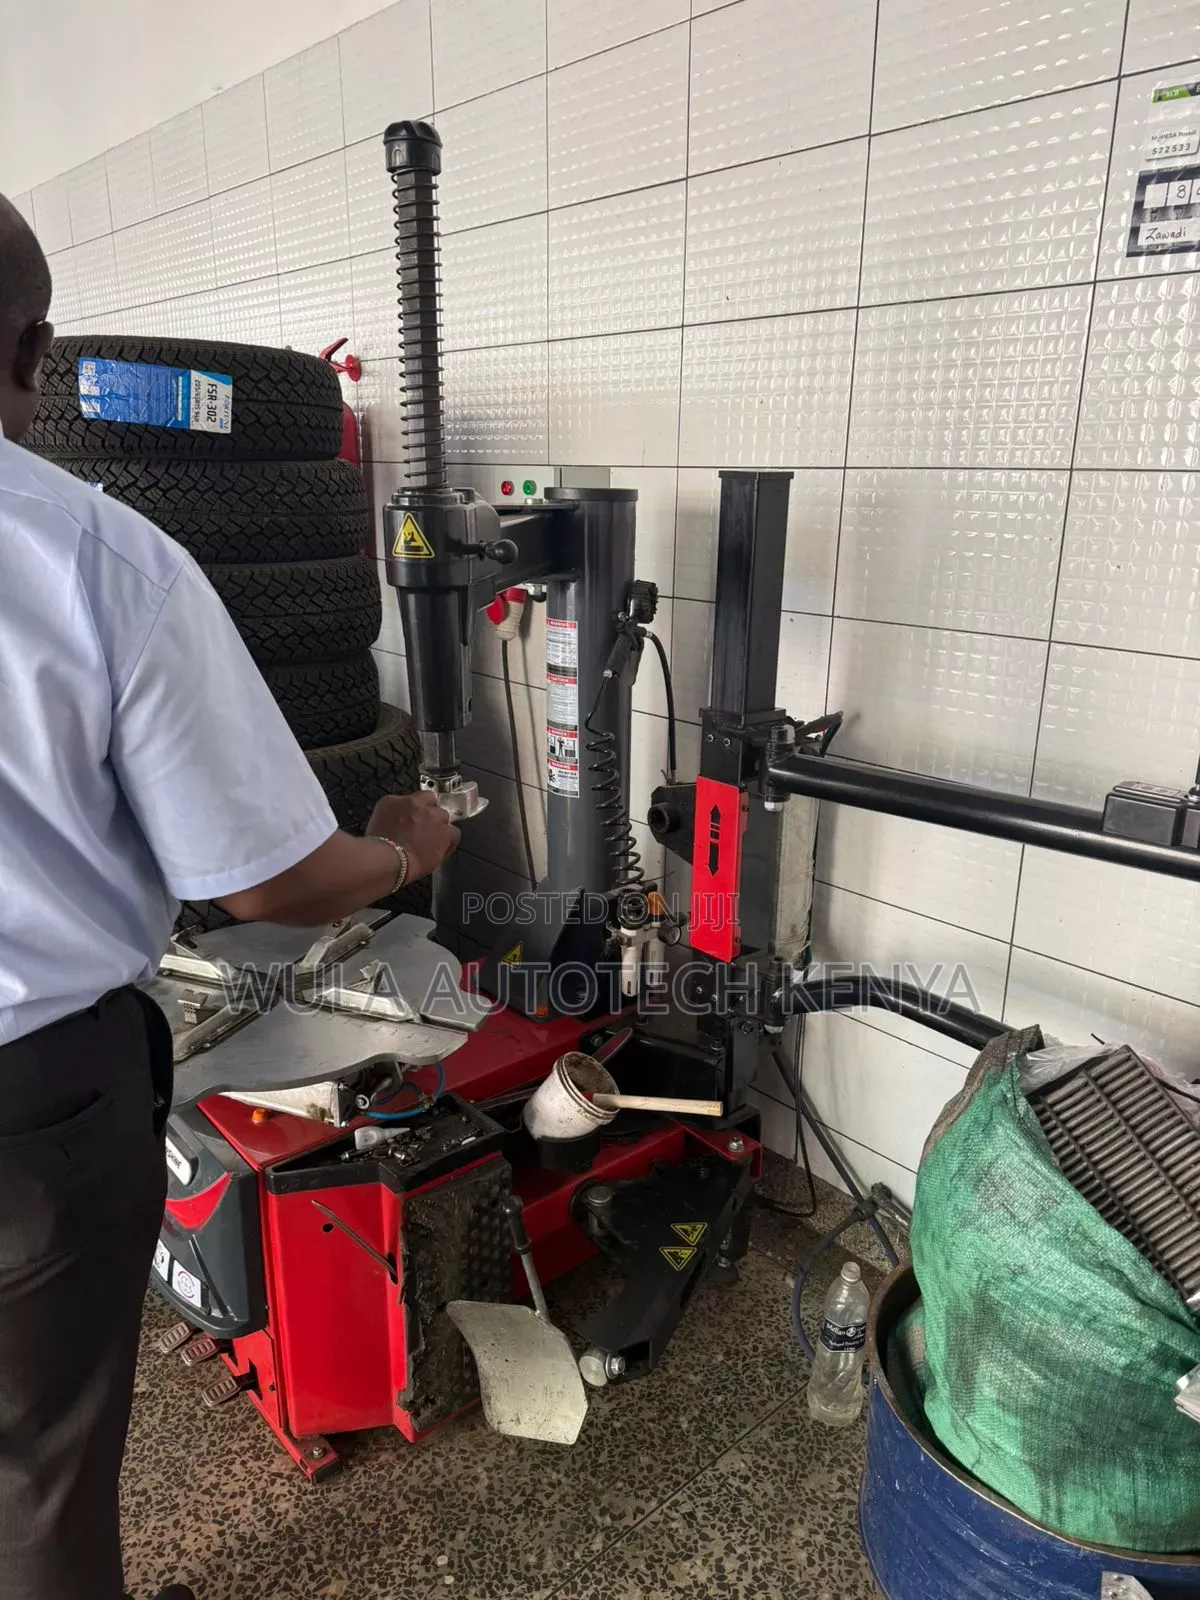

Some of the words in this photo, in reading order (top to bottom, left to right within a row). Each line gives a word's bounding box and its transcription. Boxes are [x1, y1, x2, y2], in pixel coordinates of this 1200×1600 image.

[1152, 142, 1191, 155] 522533
[206, 383, 217, 423] FSR-302
[166, 1147, 182, 1169] SHINE
